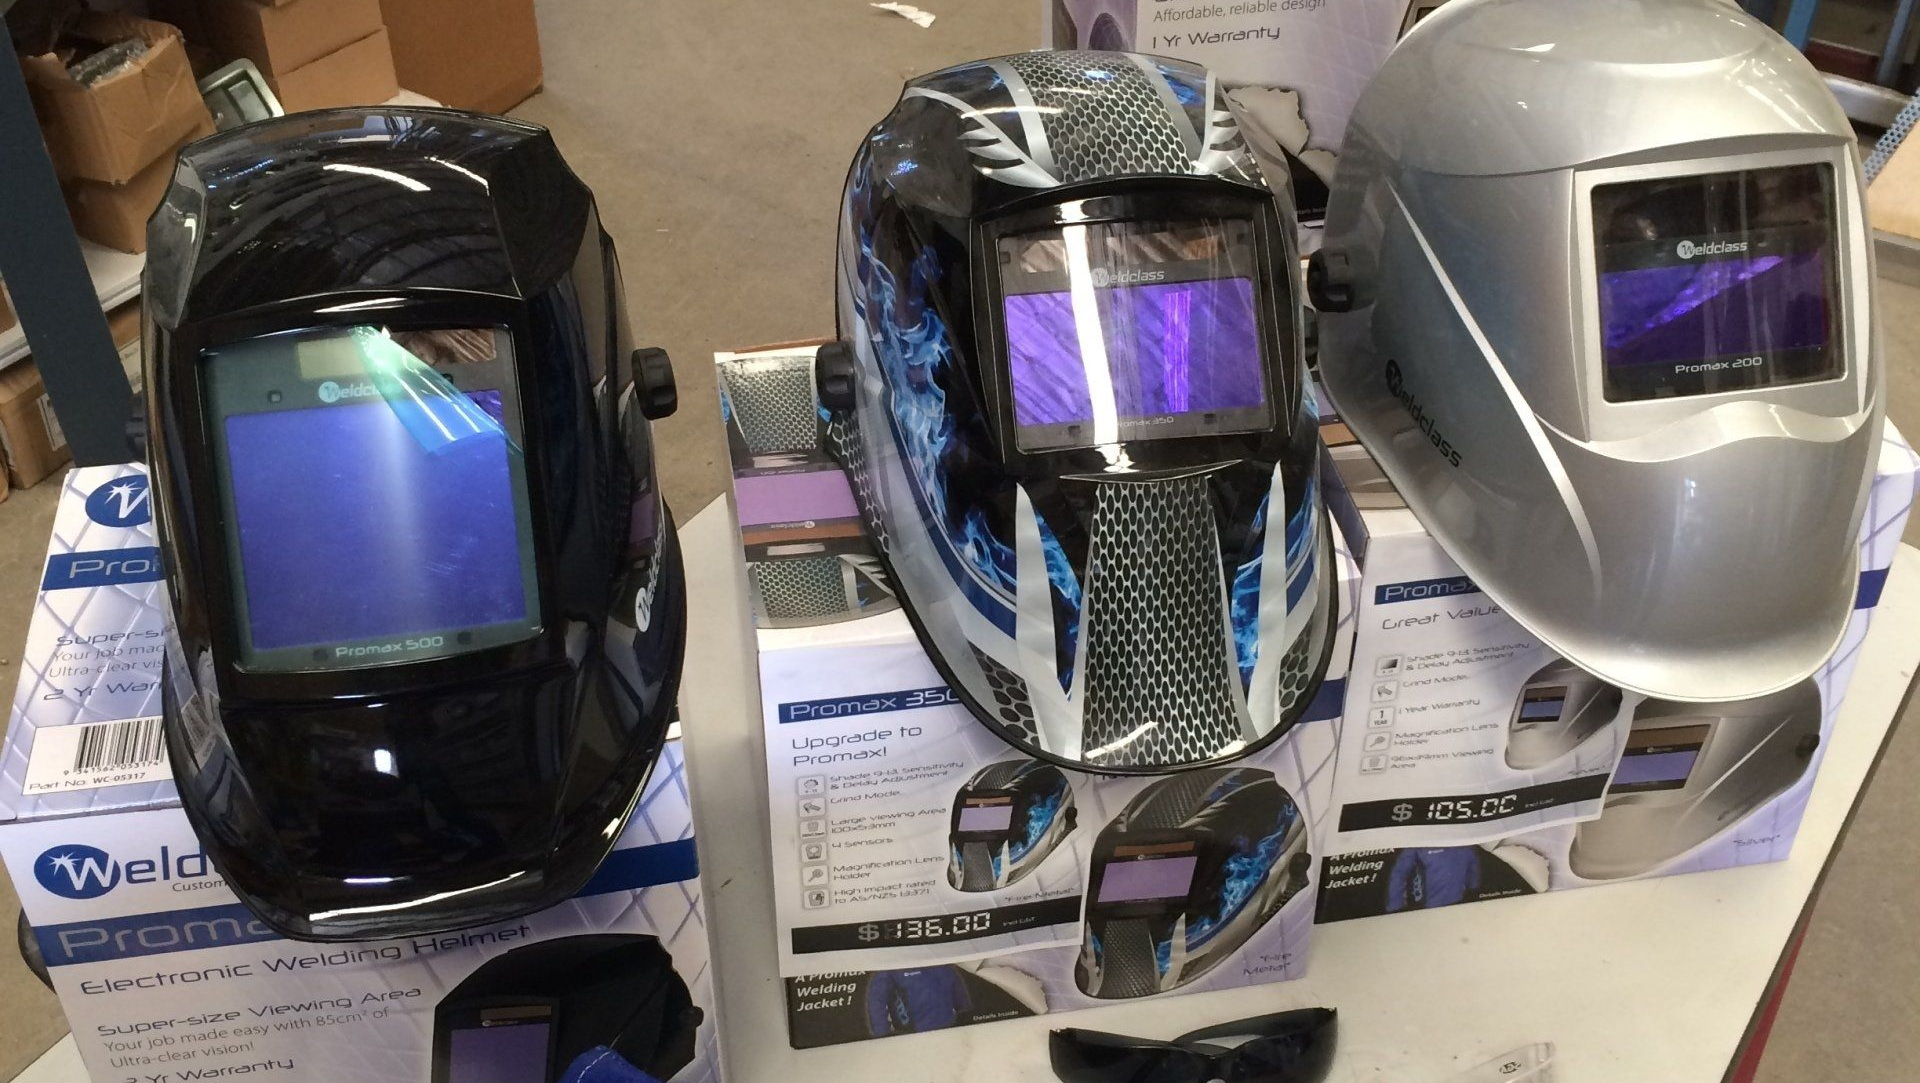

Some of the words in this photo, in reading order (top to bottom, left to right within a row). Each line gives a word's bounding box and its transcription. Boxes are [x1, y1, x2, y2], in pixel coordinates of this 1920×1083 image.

[1153, 4, 1226, 22] Affordable,
[1229, 0, 1278, 16] reliable
[1281, 0, 1326, 12] design
[1163, 35, 1182, 47] Yr
[1188, 26, 1281, 45] Warranty
[1677, 239, 1748, 259] Weldclass
[1675, 361, 1729, 374] Promax
[1732, 356, 1762, 368] 200
[69, 559, 160, 579] Pro
[1382, 613, 1440, 630] Great
[53, 650, 90, 662] Your
[95, 646, 123, 660] job
[335, 642, 403, 658] Promax
[405, 636, 444, 650] 500
[48, 661, 138, 678] Ultra-clear
[44, 688, 64, 700] 2
[73, 685, 98, 698] Yr
[790, 697, 896, 720] Promax
[792, 725, 893, 750] Upgrade
[899, 725, 923, 738] to
[793, 746, 887, 766] Promax!
[29, 781, 59, 791] Part
[93, 772, 146, 785] WC-05317
[830, 772, 870, 783] Shade
[902, 761, 964, 774] Sensitivity
[843, 780, 879, 790] Delay
[881, 770, 948, 785] Adjustment
[830, 794, 862, 804] Grind
[831, 817, 866, 826] Large
[918, 807, 947, 815] Area
[1390, 803, 1413, 822] $
[845, 837, 893, 848] Sensors
[833, 859, 912, 873] Magnification
[915, 855, 945, 864] Lens
[1329, 860, 1384, 875] Welding
[833, 872, 871, 880] Holder
[1325, 875, 1370, 889] Jacket
[834, 888, 861, 896] High
[906, 879, 936, 889] rated
[849, 892, 897, 903] AS/NZS
[858, 923, 880, 941] $
[896, 912, 990, 939] 136.00
[80, 963, 253, 996] Electronic
[262, 945, 401, 973] Welding
[413, 924, 531, 954] Helmet
[797, 982, 857, 998] Welding
[98, 1010, 241, 1037] Super-size
[248, 996, 353, 1018] Viewing
[361, 986, 421, 1002] Area
[796, 998, 844, 1012] Jacket
[104, 1040, 143, 1052] Your
[148, 1035, 175, 1051] job
[180, 1027, 229, 1042] made
[233, 1024, 269, 1037] easy
[274, 1017, 311, 1032] with
[372, 1007, 391, 1020] of
[111, 1049, 199, 1069] Ultra-clear
[202, 1041, 255, 1057] vision!
[176, 1057, 295, 1082] Warranty
